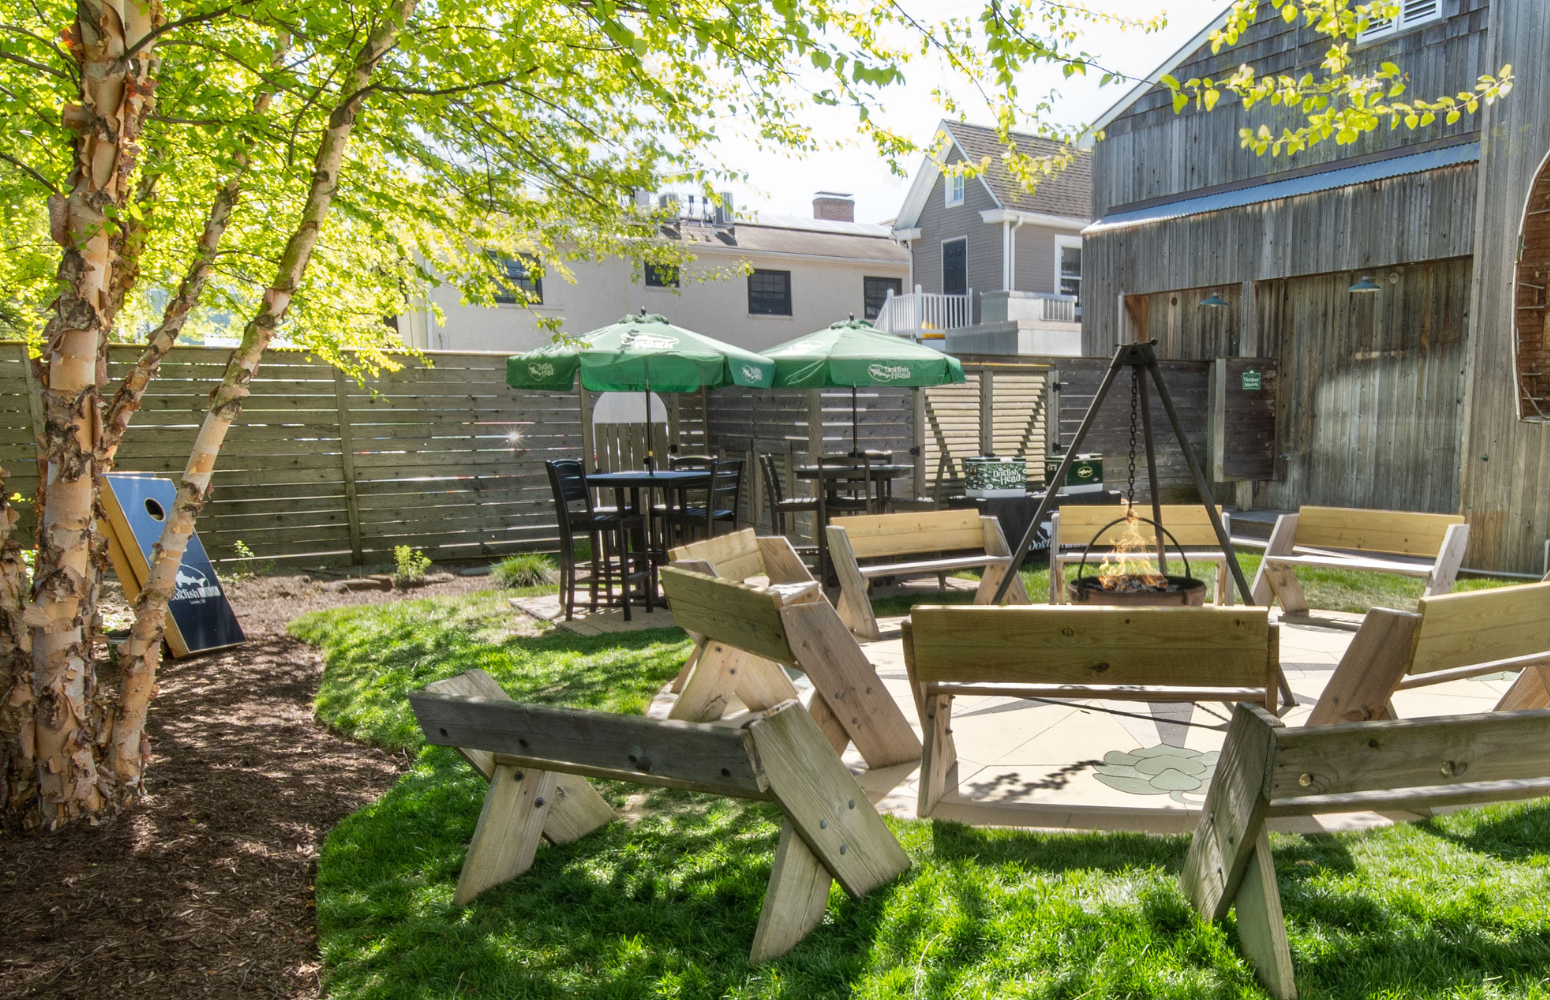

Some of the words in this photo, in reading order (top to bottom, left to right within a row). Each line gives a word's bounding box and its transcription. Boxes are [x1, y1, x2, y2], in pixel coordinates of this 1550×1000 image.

[885, 365, 909, 373] Dogfish
[891, 371, 911, 379] Head
[992, 468, 1019, 478] Dogfish
[1000, 473, 1021, 486] Head
